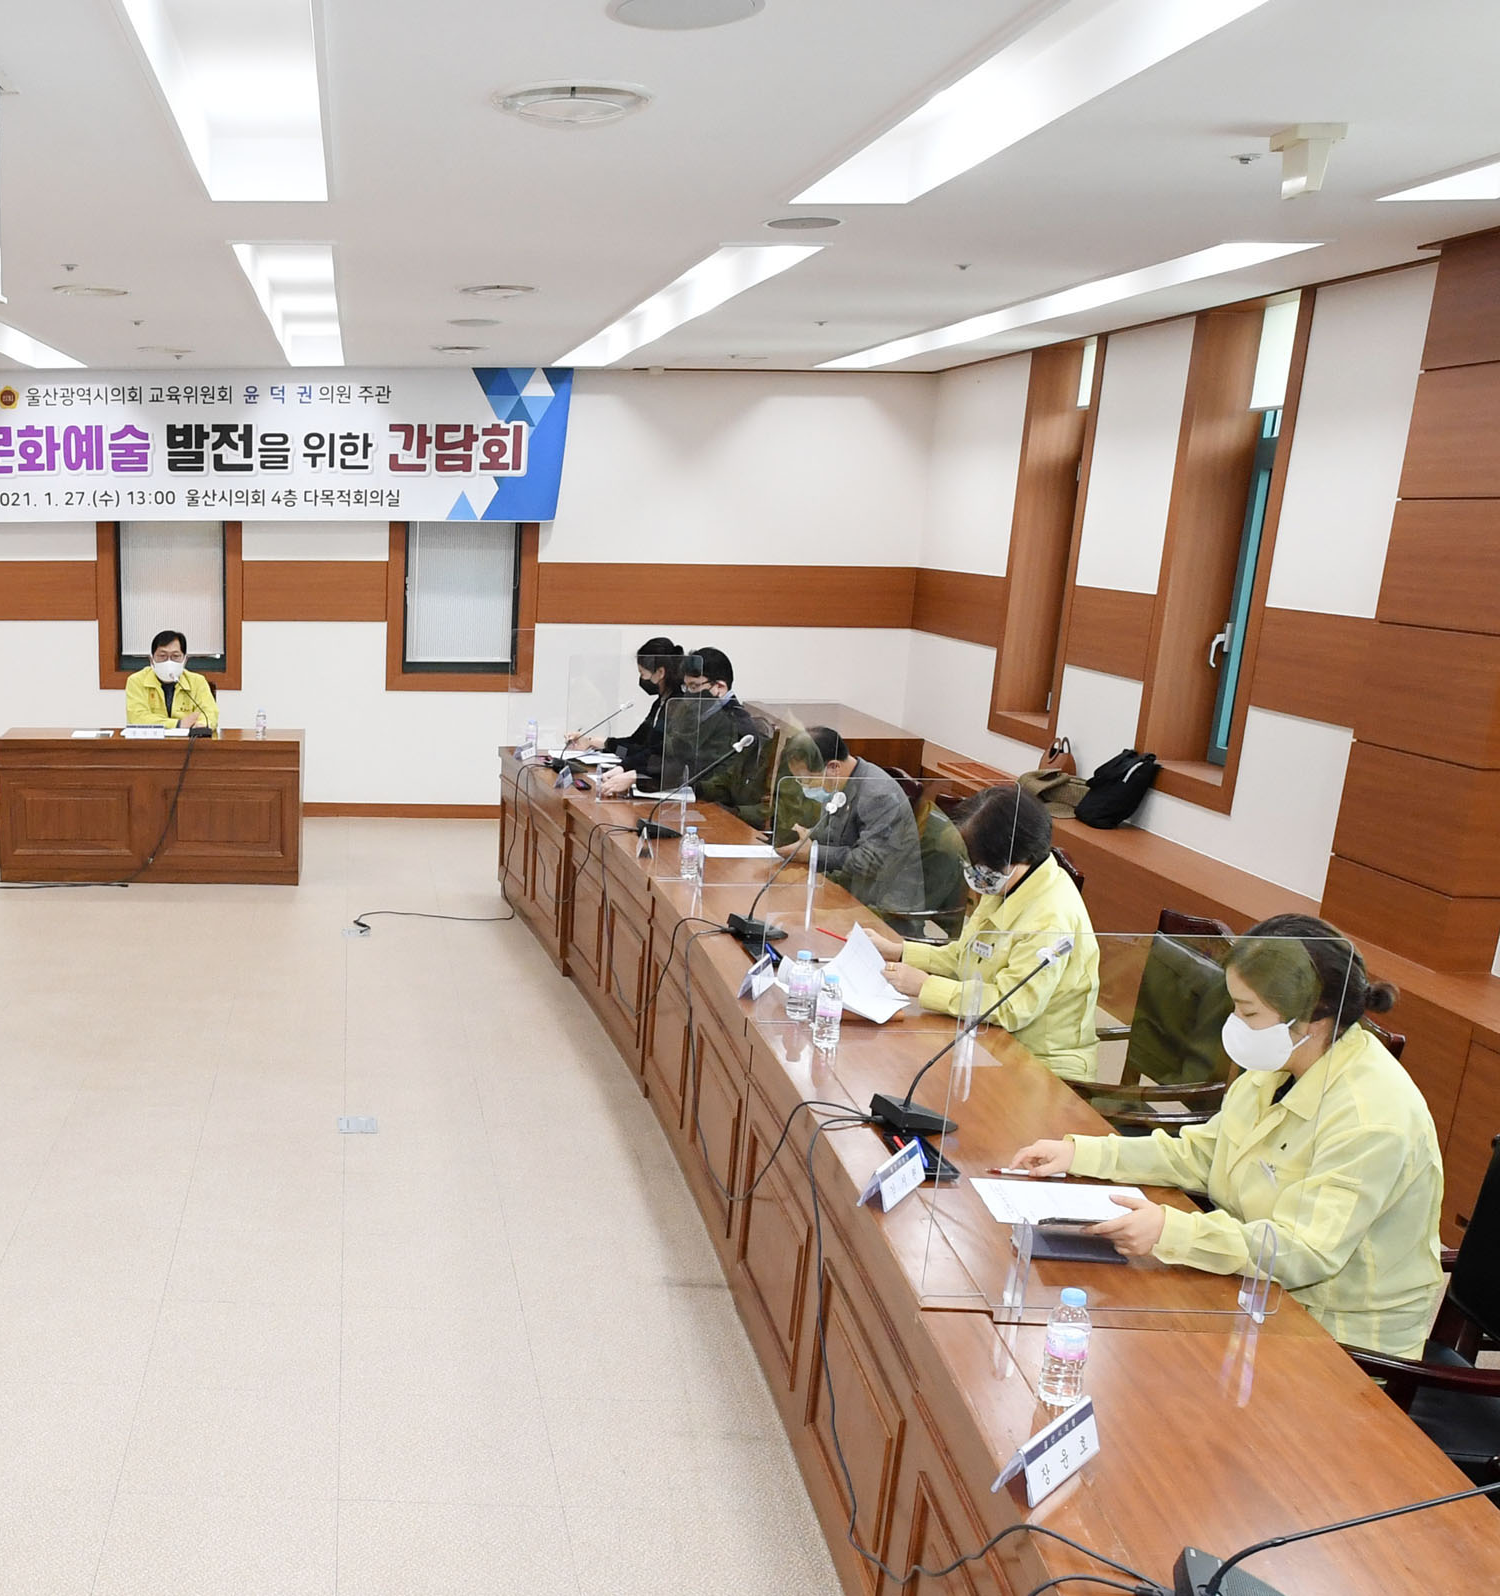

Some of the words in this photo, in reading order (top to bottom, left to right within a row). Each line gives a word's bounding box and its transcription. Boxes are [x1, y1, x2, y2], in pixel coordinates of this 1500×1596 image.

[25, 386, 142, 406] 울산광역시의회
[148, 385, 232, 405] 교육위원회
[243, 385, 260, 405] 윤
[270, 385, 285, 405] 덕
[296, 385, 312, 405] 권
[318, 385, 351, 405] 의원
[357, 385, 392, 405] 주관
[166, 423, 291, 473] 발전을
[302, 432, 374, 471] 위한
[388, 423, 522, 473] 간담회
[44, 492, 59, 508] 1.
[64, 489, 120, 508] 27.(수)
[126, 490, 176, 506] 13:00
[185, 488, 266, 508] 울산시의회
[271, 488, 298, 508] 4층
[303, 488, 401, 508] 다목적회의실
